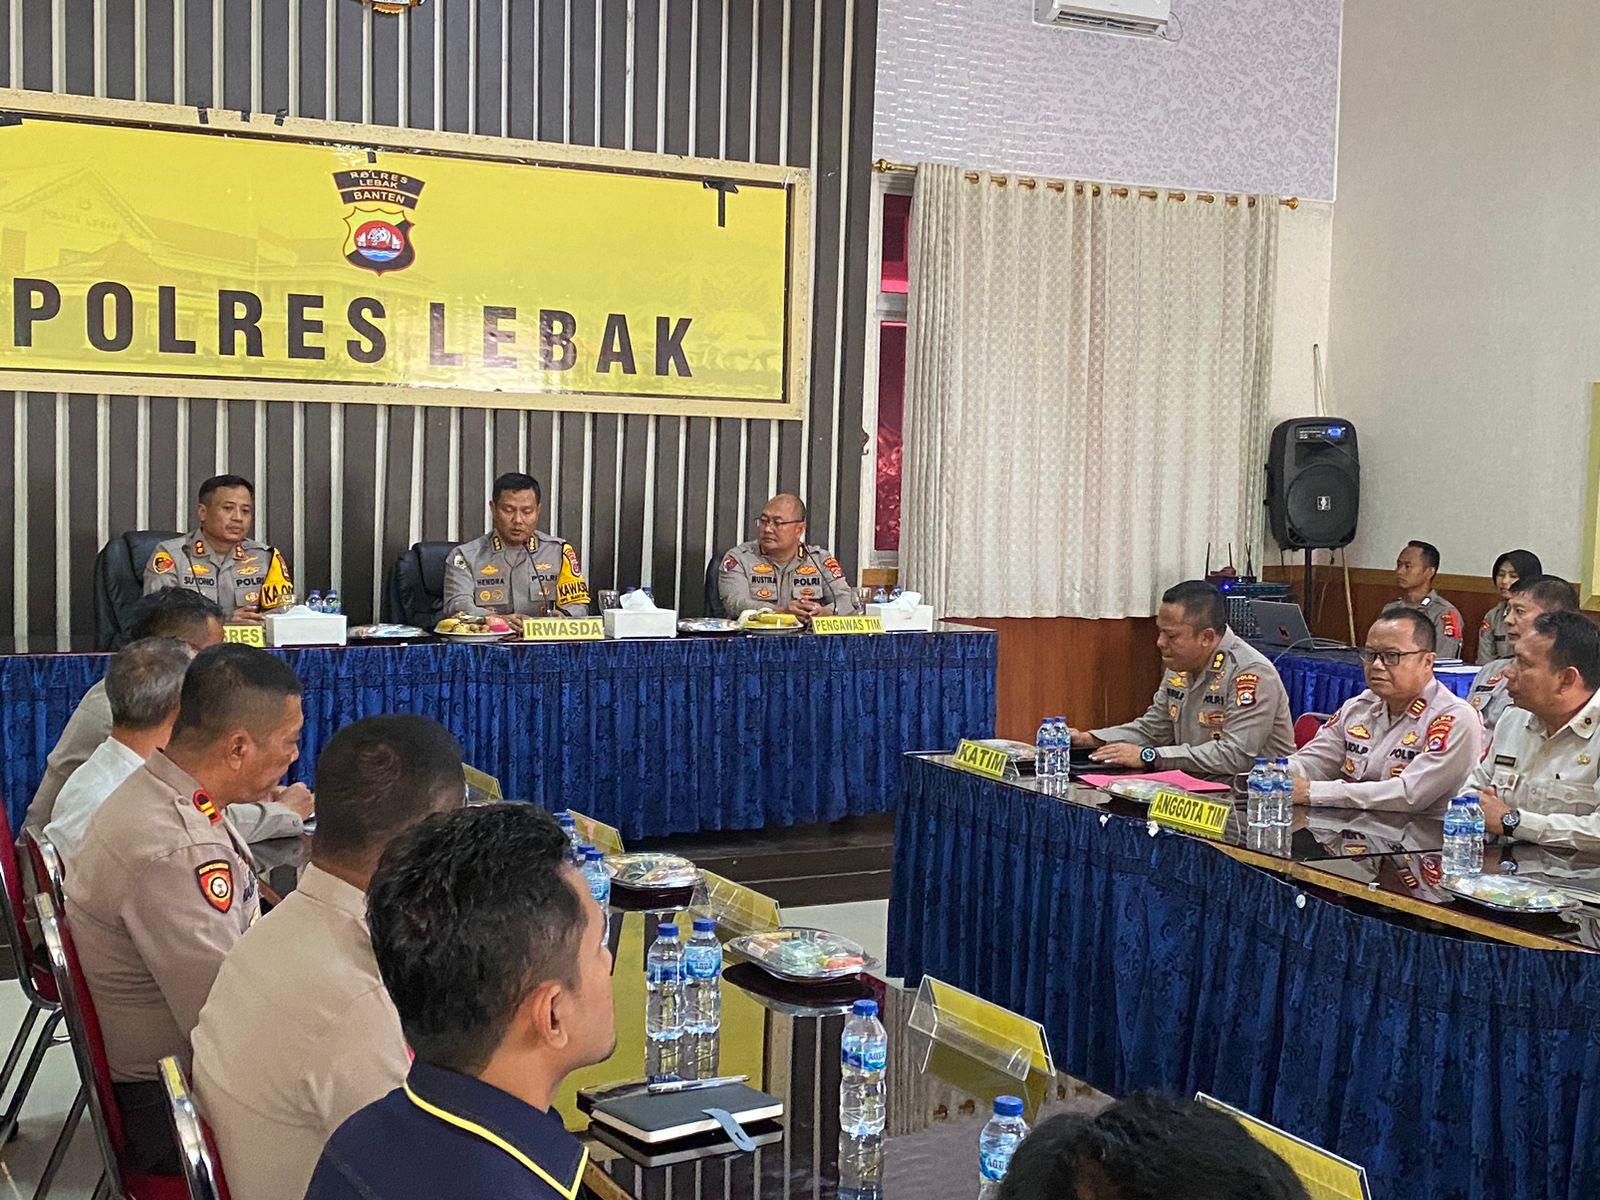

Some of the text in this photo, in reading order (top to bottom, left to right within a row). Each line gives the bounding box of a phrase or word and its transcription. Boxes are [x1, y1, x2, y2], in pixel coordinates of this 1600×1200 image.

[350, 170, 408, 185] POLRES
[359, 178, 398, 189] LEBAK
[353, 191, 405, 204] BANTEN
[13, 277, 693, 378] POLRES LEBAK
[476, 578, 505, 587] HENDRA
[531, 575, 558, 583] POLRI
[793, 576, 820, 586] POLRI
[525, 621, 602, 636] IRWASDA
[815, 618, 882, 632] PENGAWAS TIM
[957, 744, 1006, 773] KATIM
[1154, 792, 1227, 828] ANGGOTA TIM
